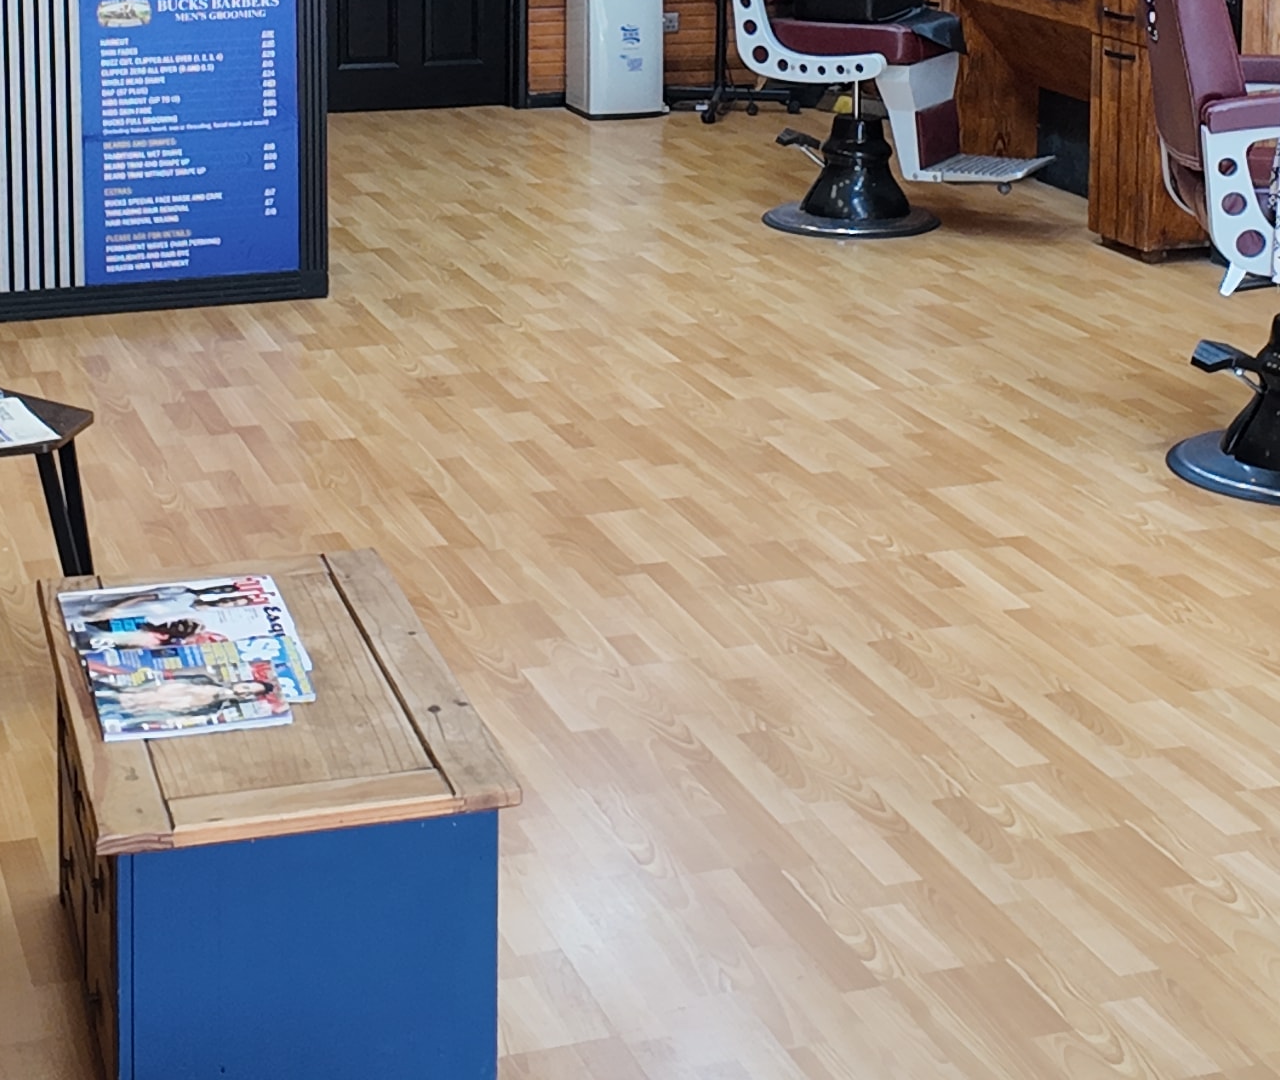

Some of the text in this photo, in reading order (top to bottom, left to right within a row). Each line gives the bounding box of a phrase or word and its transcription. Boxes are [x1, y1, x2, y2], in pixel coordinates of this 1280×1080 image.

[175, 9, 266, 21] MEN'S GROOMING
[160, 66, 177, 74] OVER
[104, 172, 126, 180] BEARD
[128, 197, 154, 205] SPECIAL
[106, 234, 131, 242] PLEASE
[106, 243, 145, 253] PERMANENT
[152, 259, 189, 269] TREATMENT
